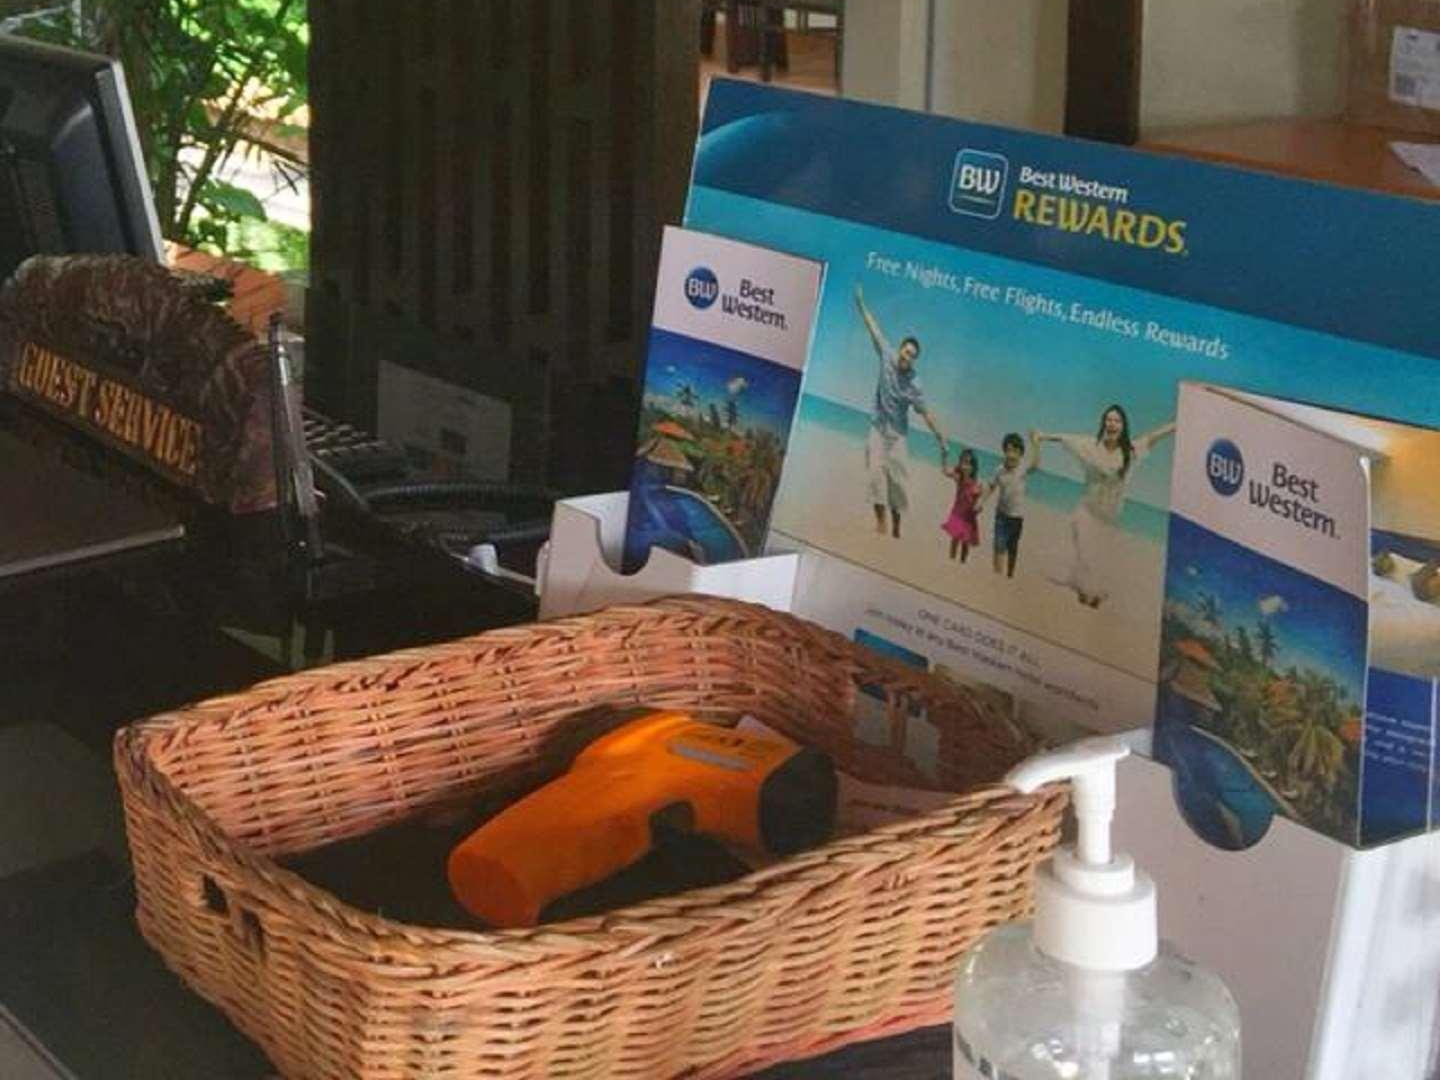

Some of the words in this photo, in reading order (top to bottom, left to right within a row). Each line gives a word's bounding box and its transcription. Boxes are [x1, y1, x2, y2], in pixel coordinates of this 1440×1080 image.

[958, 164, 1001, 194] BW
[1019, 167, 1056, 189] Best
[1058, 173, 1128, 203] Western
[1013, 189, 1188, 254] REWARDS
[687, 277, 719, 299] BW
[740, 278, 774, 305] Best
[867, 251, 901, 277] Free
[905, 261, 960, 294] Nights,
[963, 276, 1000, 301] Free
[1005, 286, 1067, 322] Flights,
[1069, 302, 1139, 337] Endless
[1145, 321, 1229, 360] Rewards
[16, 341, 98, 417] GUEST
[93, 379, 202, 475] SERVICE
[1210, 452, 1242, 485] BW
[1273, 461, 1320, 503] Best
